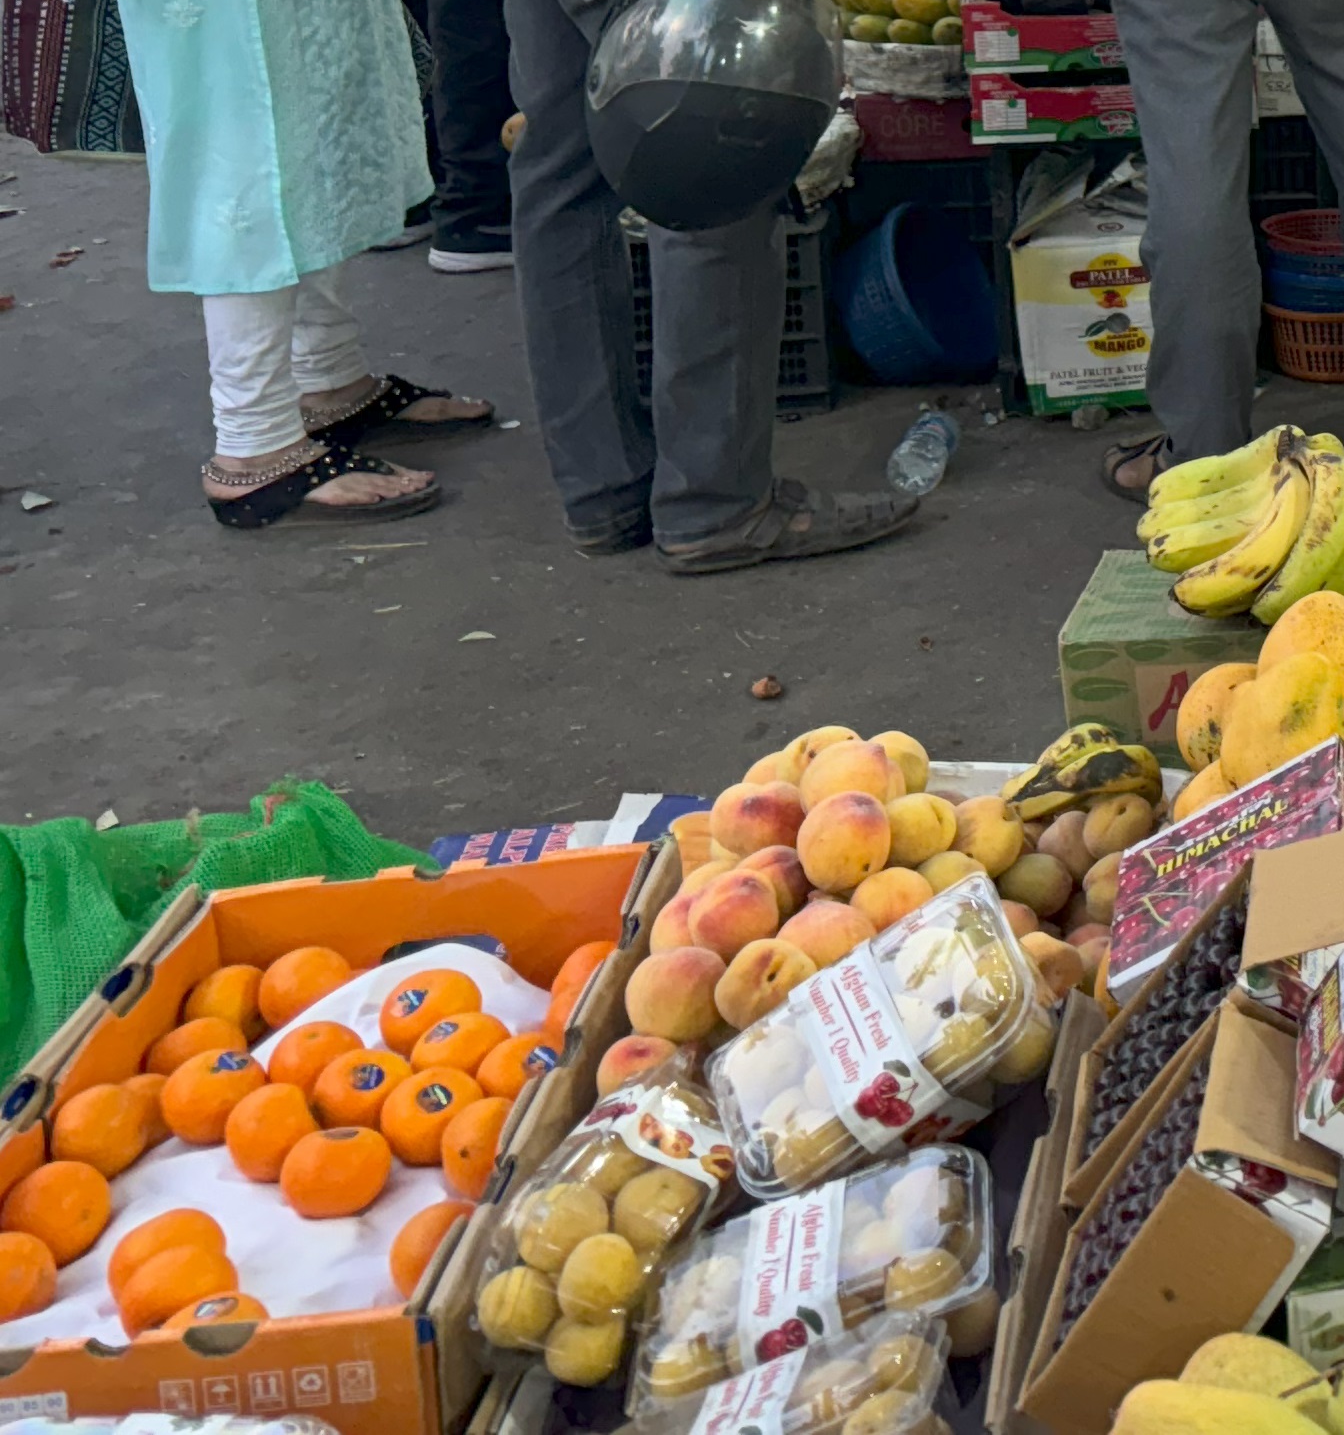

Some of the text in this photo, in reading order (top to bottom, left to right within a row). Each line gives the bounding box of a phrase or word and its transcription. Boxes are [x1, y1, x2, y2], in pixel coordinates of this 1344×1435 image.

[1089, 268, 1134, 282] PATEL
[1050, 368, 1079, 380] PATEL
[1083, 366, 1113, 378] FRUIT
[1127, 362, 1149, 374] VEG
[1094, 339, 1146, 353] MANGO
[1157, 798, 1290, 879] HIMACHAL
[809, 976, 838, 1029] Number
[828, 1037, 861, 1085] Quality
[839, 962, 896, 1052] Afghan Fresh
[767, 1206, 792, 1256] Number
[799, 1202, 825, 1292] Afghan Fresh
[751, 1268, 781, 1317] Quality
